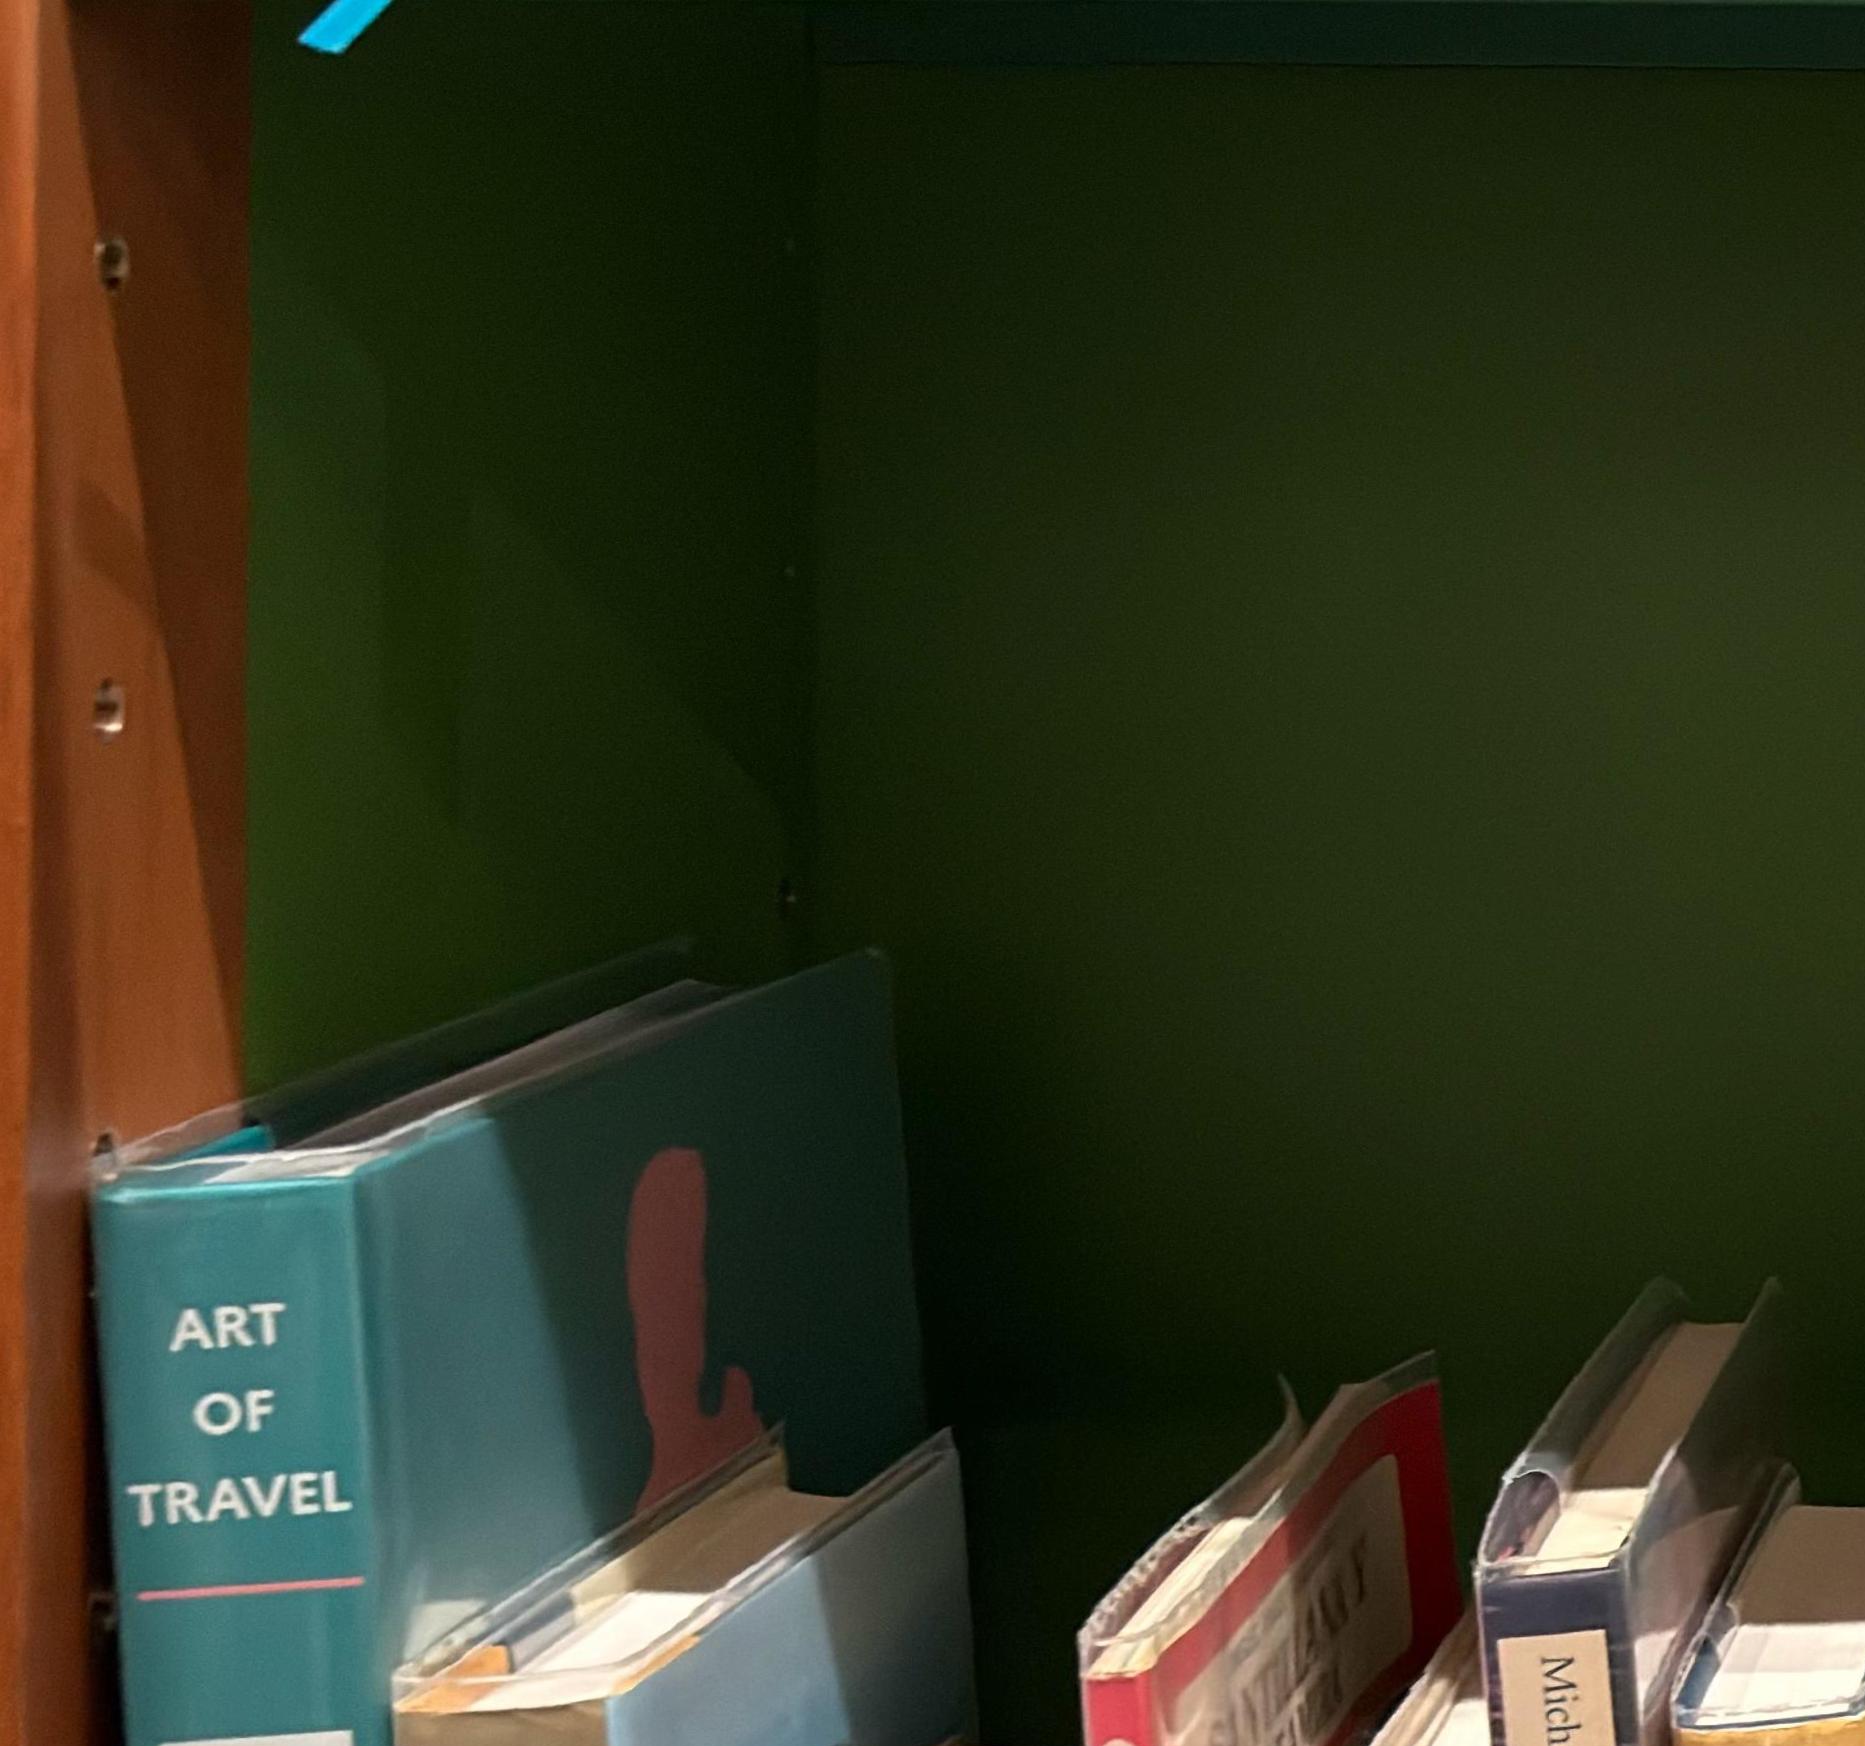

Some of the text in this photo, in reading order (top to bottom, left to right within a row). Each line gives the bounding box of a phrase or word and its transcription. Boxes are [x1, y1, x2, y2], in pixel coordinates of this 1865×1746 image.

[170, 1302, 284, 1352] ART
[193, 1389, 275, 1436] OF
[128, 1470, 352, 1528] TRAVEL
